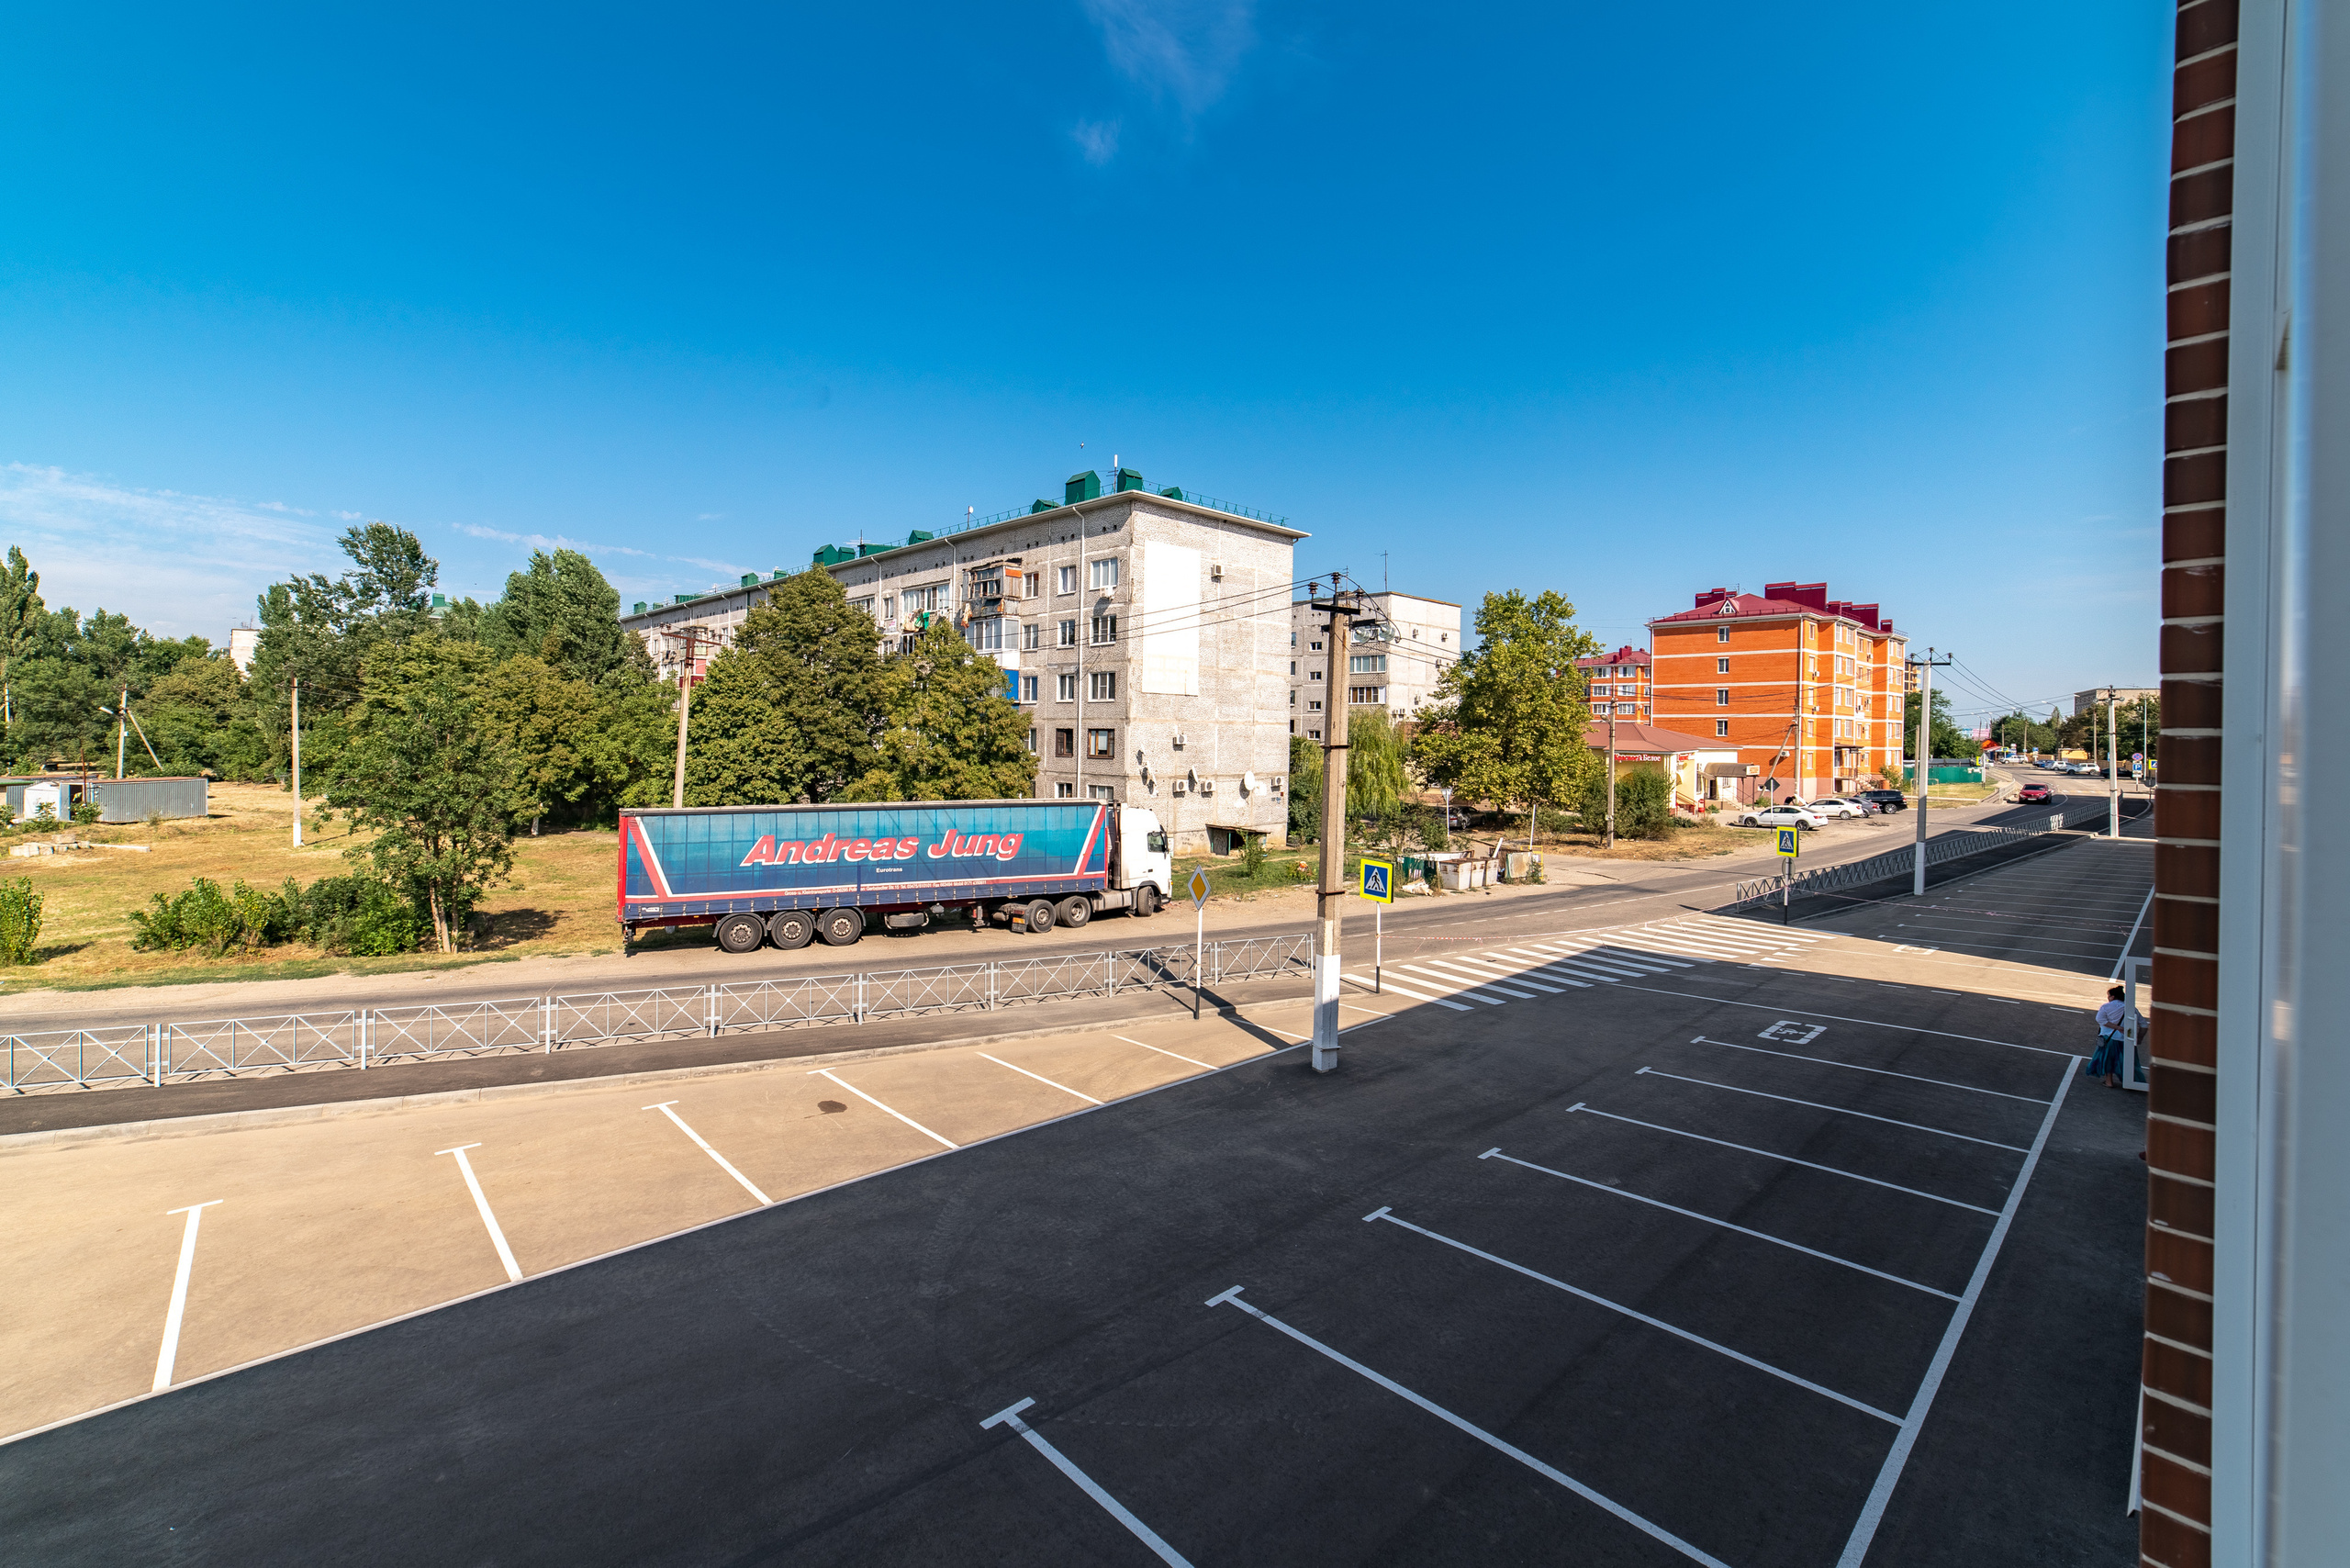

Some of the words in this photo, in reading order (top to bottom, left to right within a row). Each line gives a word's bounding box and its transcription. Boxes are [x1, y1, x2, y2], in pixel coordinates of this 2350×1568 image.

[1643, 754, 1662, 762] Белое
[739, 833, 919, 867] Andreas
[927, 829, 1024, 862] Jung
